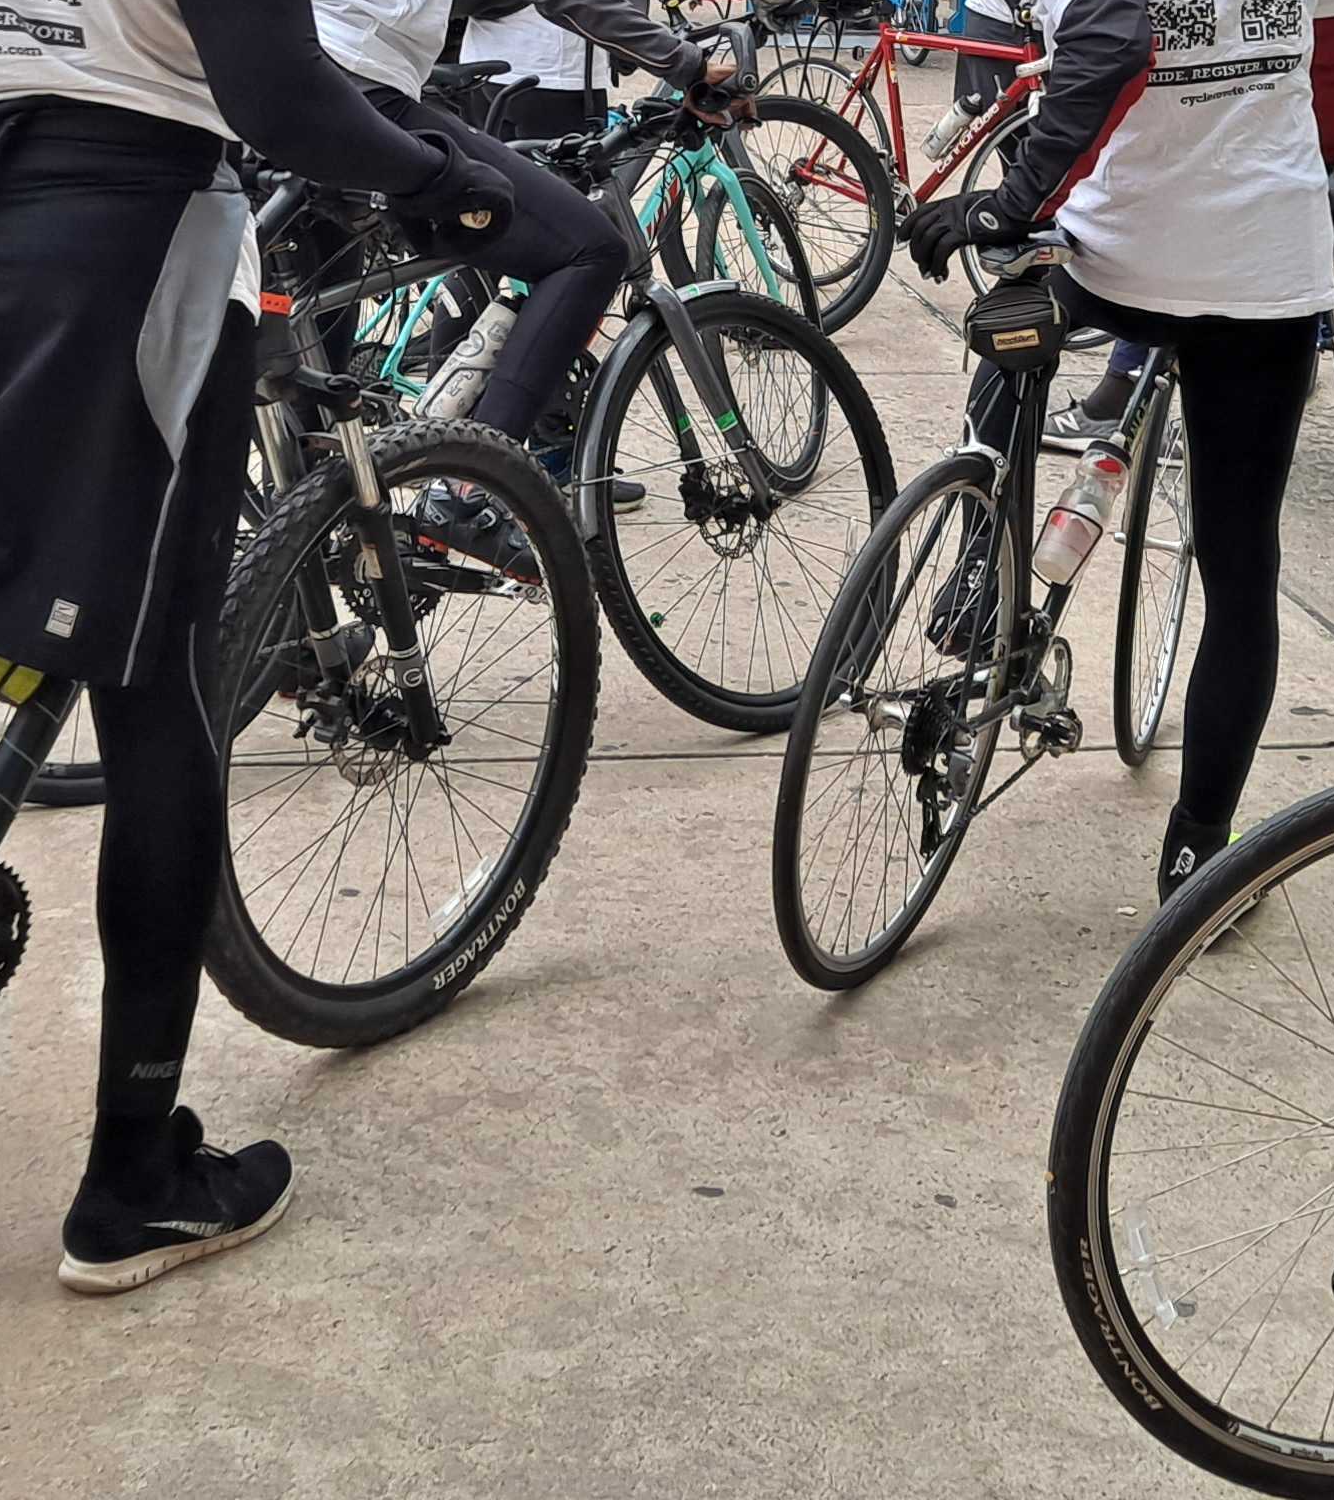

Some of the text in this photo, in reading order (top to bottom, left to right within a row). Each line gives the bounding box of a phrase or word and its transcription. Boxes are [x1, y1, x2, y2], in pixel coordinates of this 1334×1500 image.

[433, 876, 527, 991] BONTRAGER
[129, 1060, 179, 1080] NIKE
[1078, 1236, 1164, 1411] BONTRAGER
